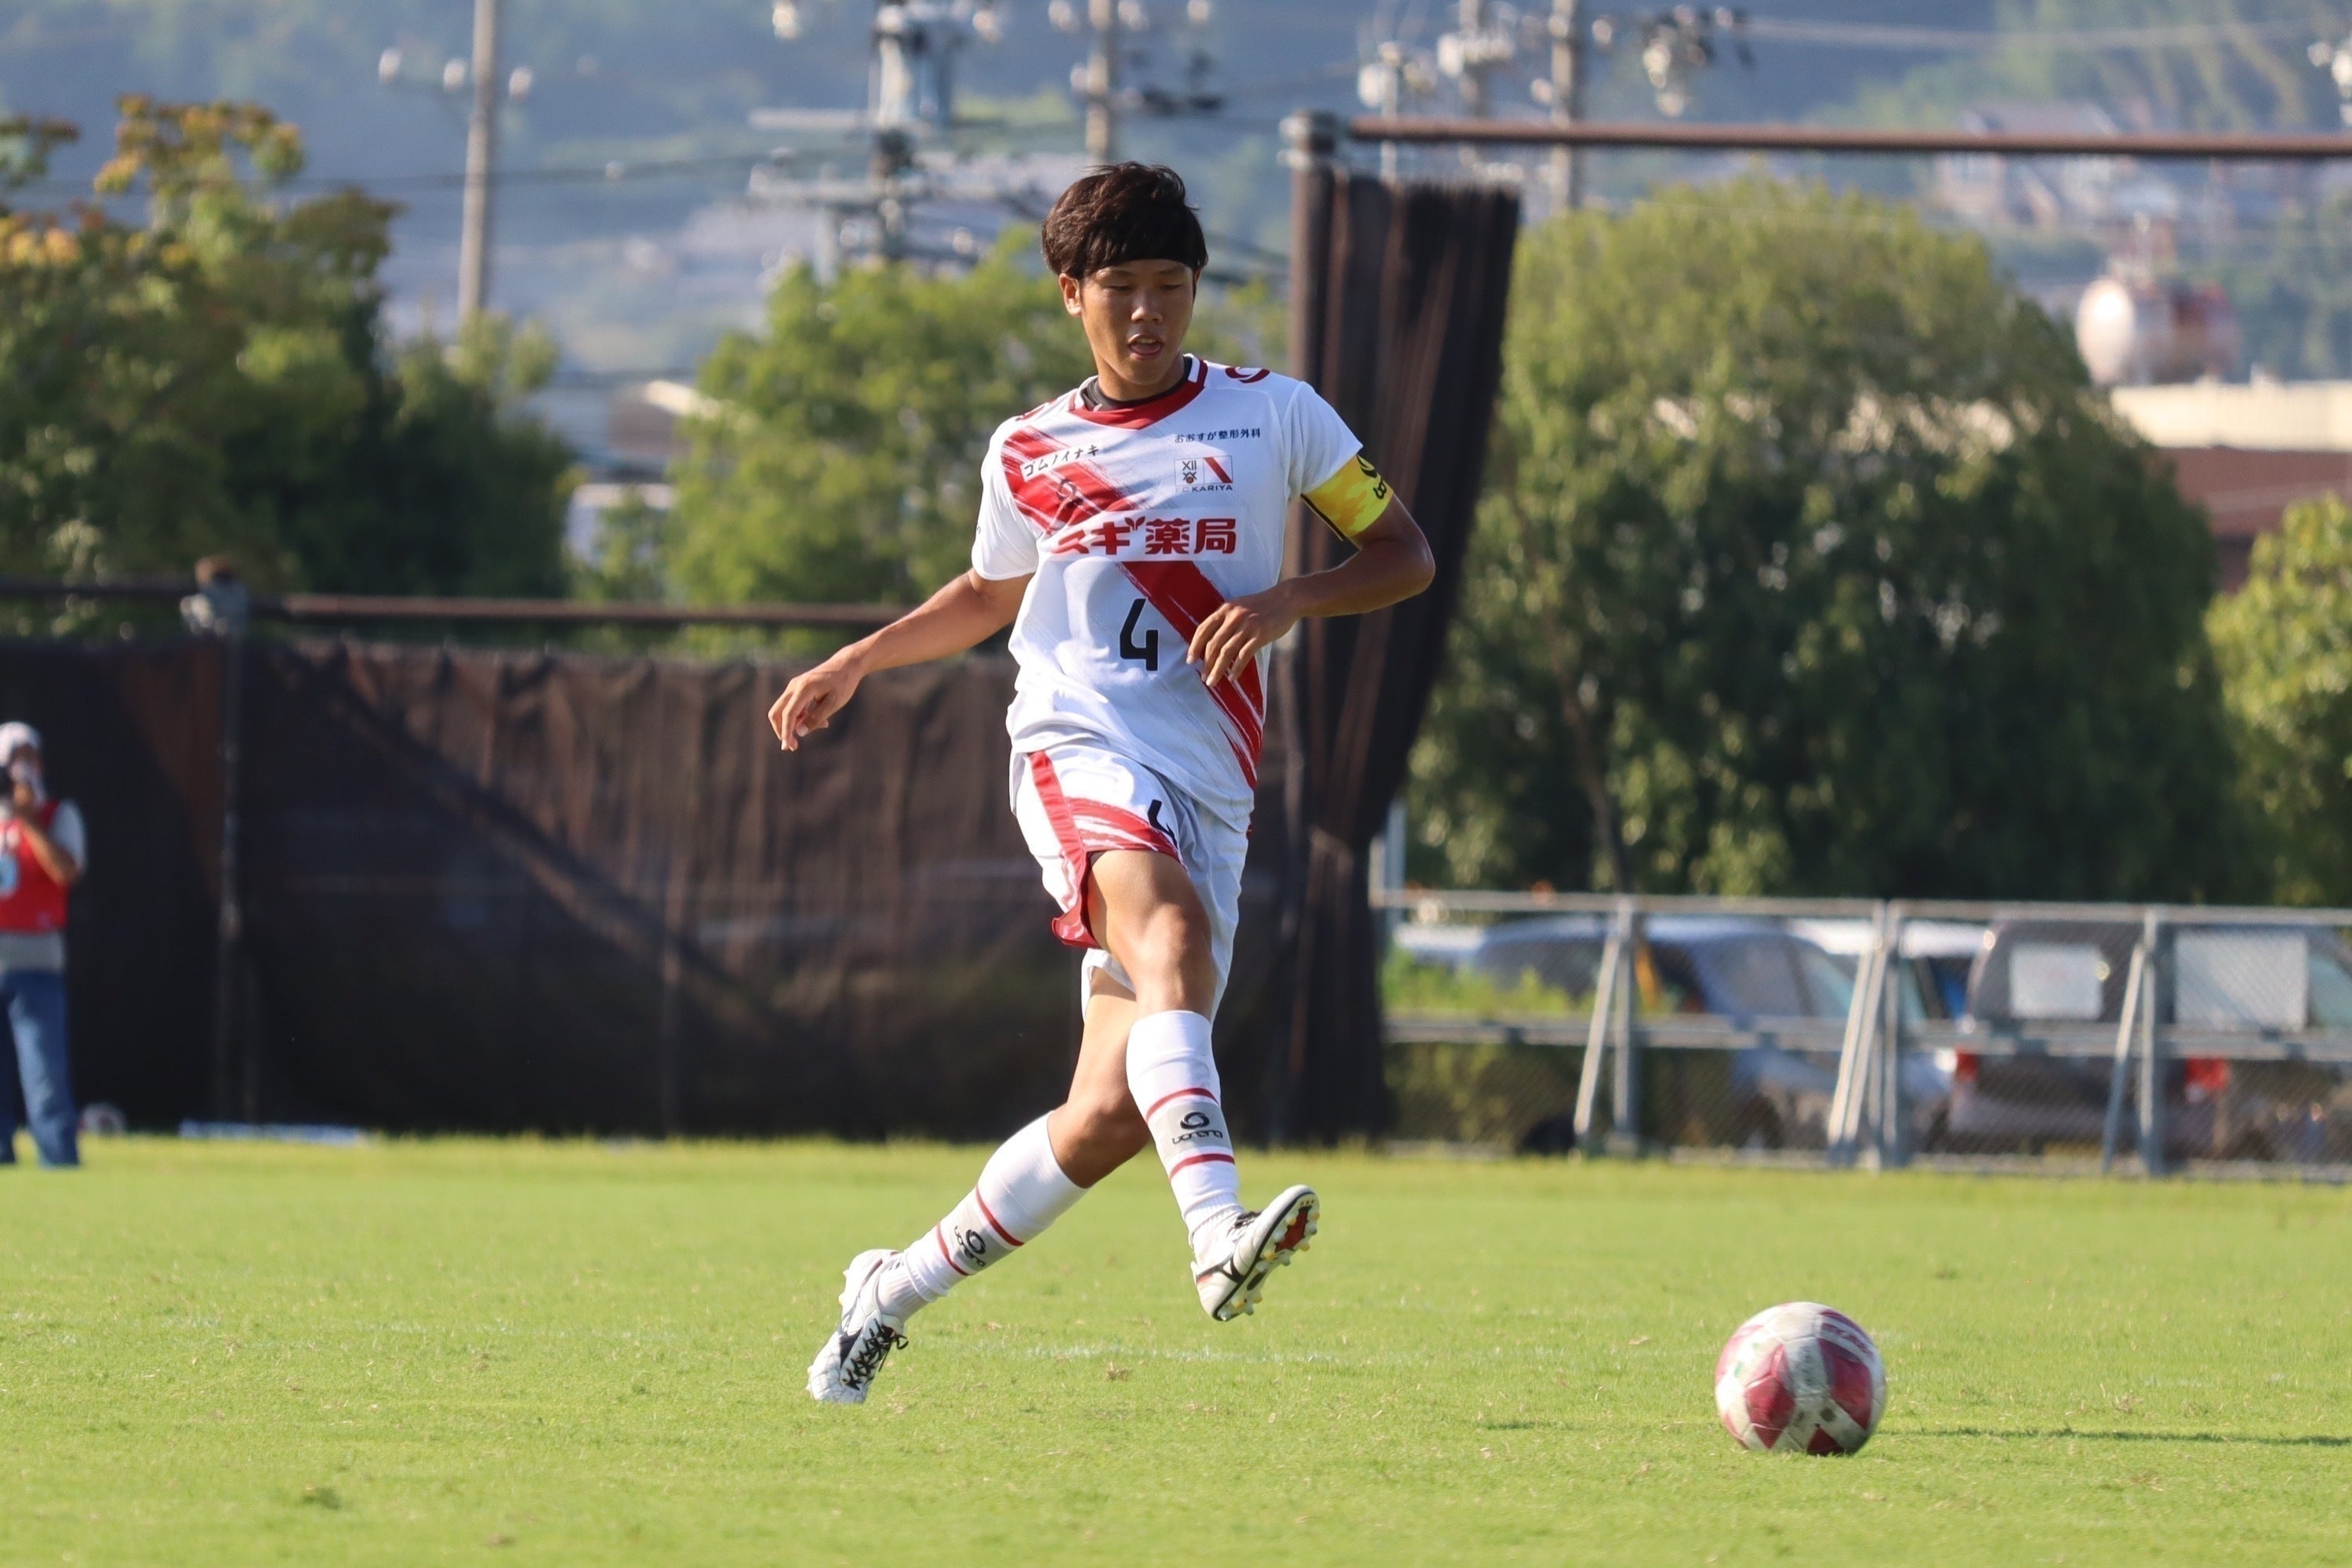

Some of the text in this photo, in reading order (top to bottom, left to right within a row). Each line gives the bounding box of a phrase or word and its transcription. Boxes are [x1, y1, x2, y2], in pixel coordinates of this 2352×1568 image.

[1174, 427, 1261, 443] おおすが整形外科
[1024, 445, 1099, 477] ゴムノイナキ
[1120, 598, 1158, 671] 4
